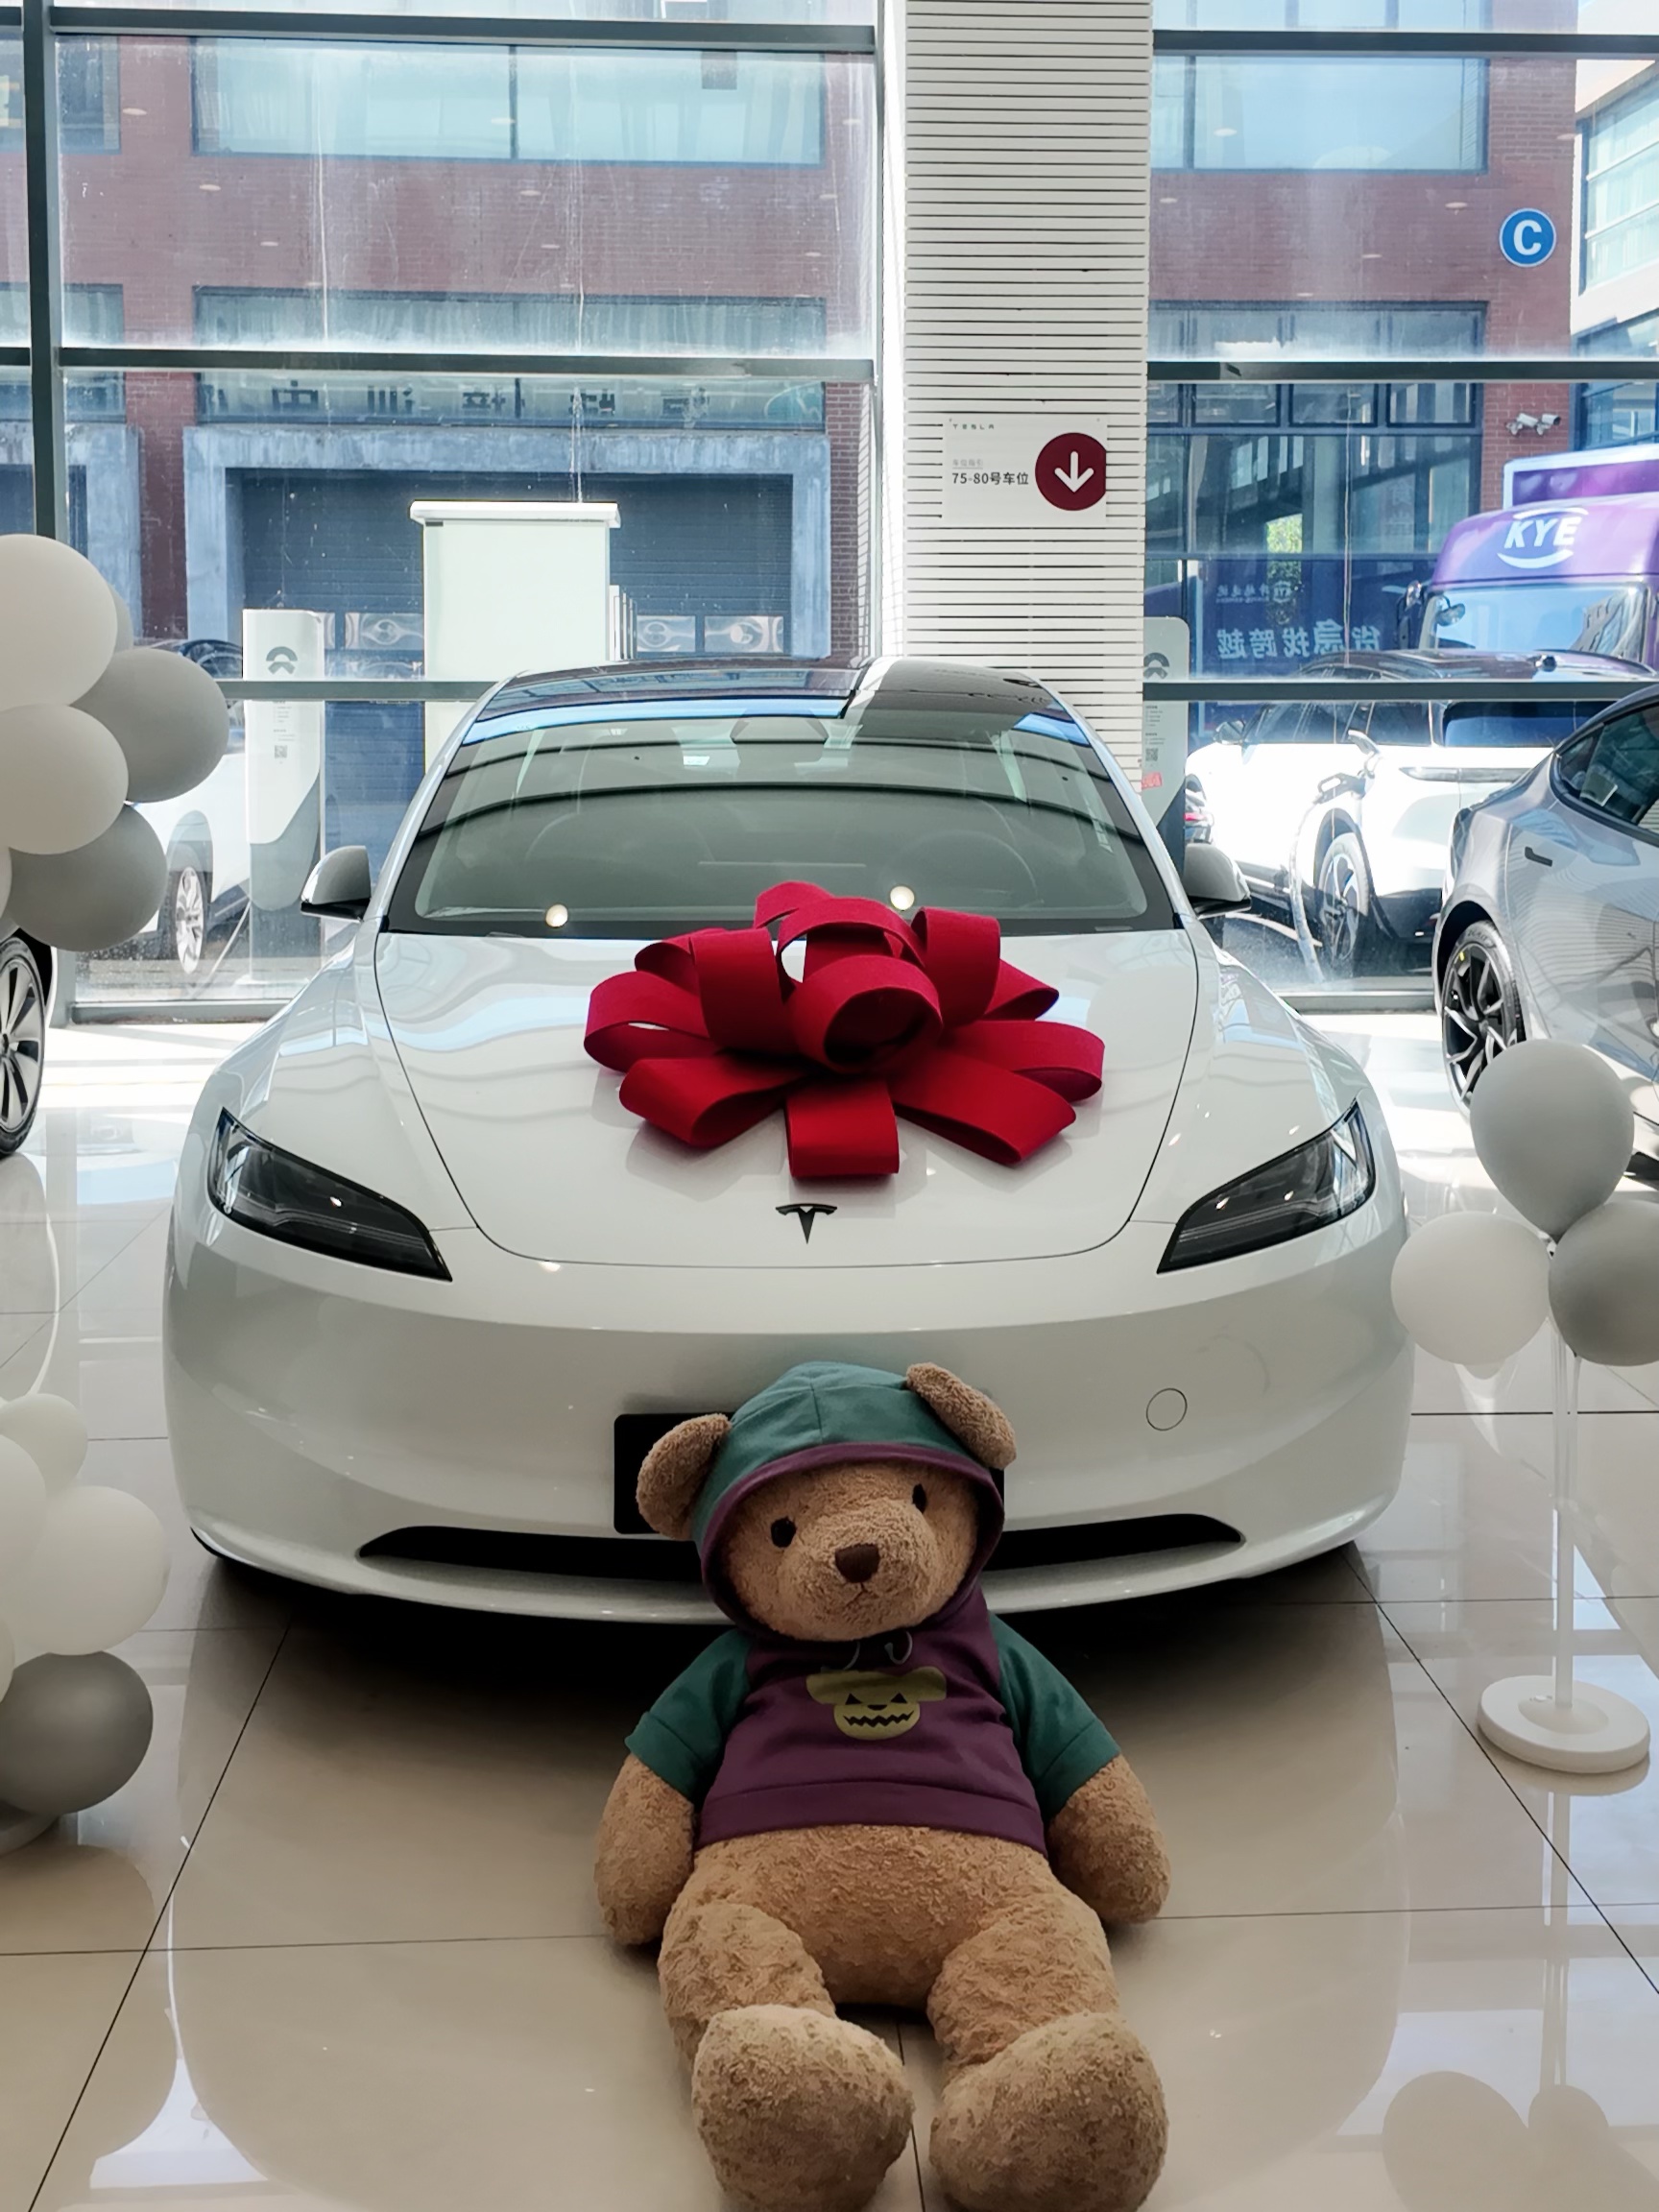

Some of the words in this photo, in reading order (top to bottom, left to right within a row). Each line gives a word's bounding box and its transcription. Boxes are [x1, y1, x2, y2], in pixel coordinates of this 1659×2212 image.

[1513, 219, 1542, 256] C
[951, 471, 1029, 486] 75-80号车位
[1503, 516, 1583, 549] KYE
